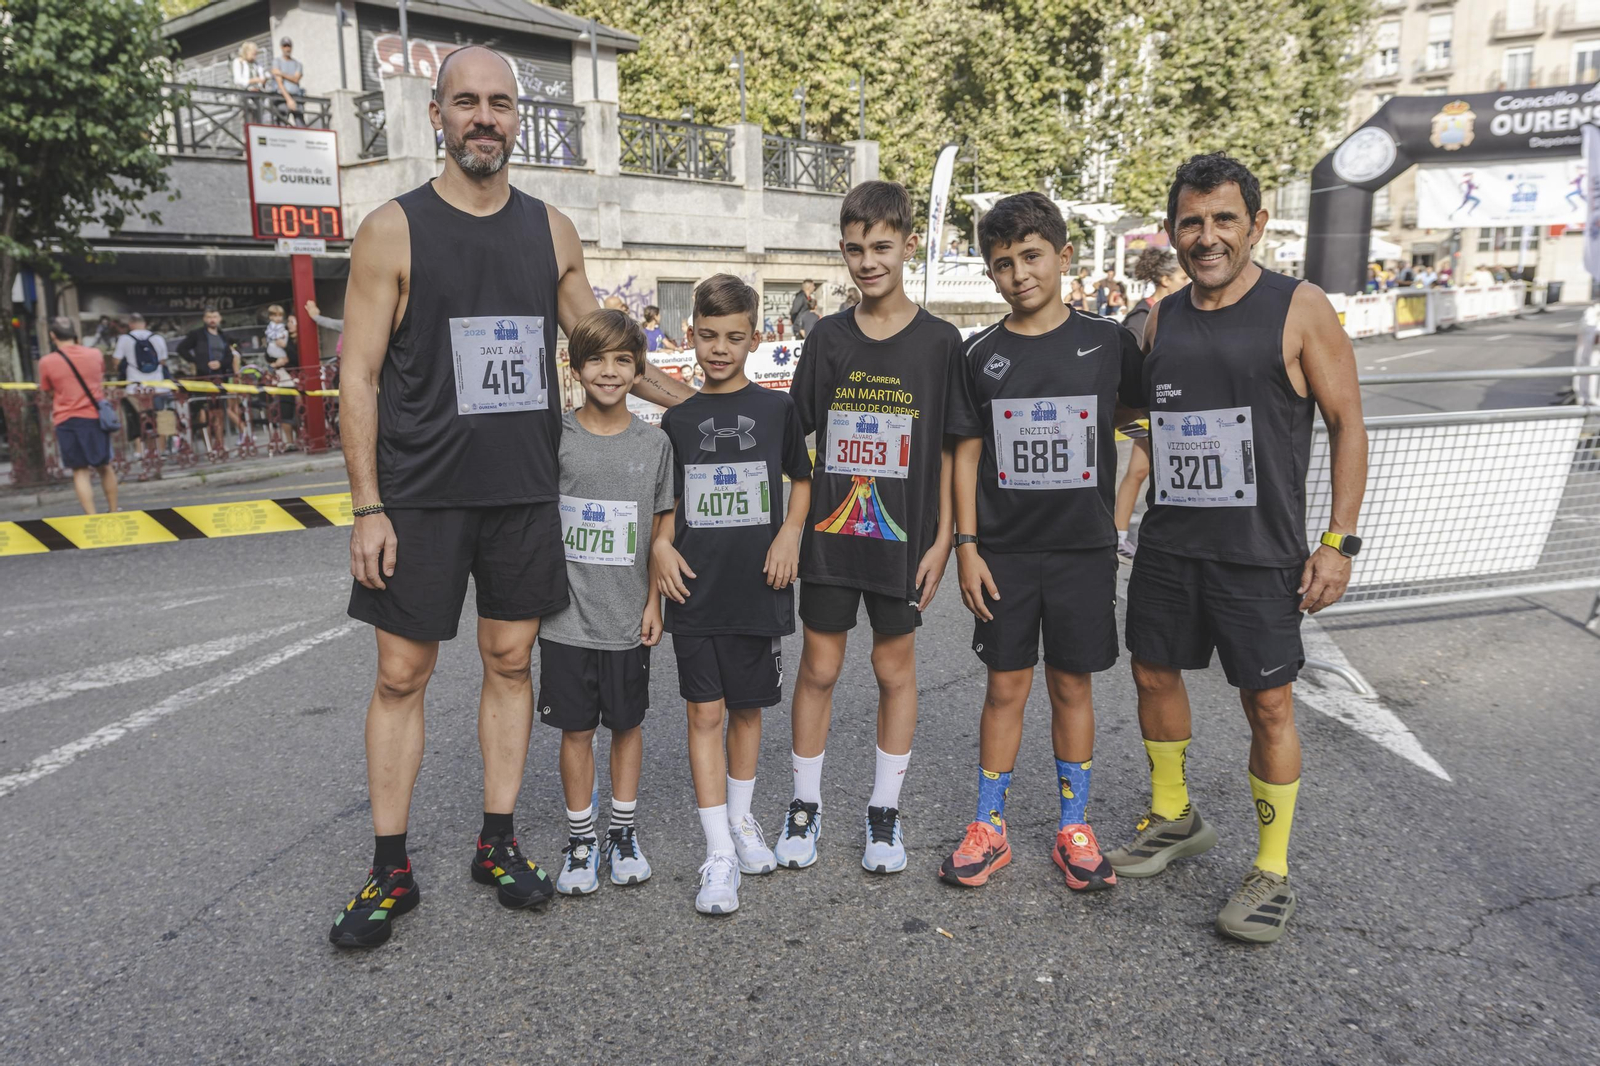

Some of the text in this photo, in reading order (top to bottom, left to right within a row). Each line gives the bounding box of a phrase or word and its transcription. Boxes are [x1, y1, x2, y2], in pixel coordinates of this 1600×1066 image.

[1494, 90, 1579, 111] Concello
[279, 165, 312, 175] Concello
[280, 174, 332, 186] OURENSE
[464, 329, 486, 337] 2026
[480, 346, 524, 355] JAVI AAA
[482, 360, 525, 395] 415
[866, 375, 901, 385] CARREIRA
[1156, 383, 1172, 391] SEVEN
[835, 387, 913, 404] SAN MARTIÑO
[1156, 389, 1182, 397] BOUTIQUE
[867, 404, 880, 413] DE
[881, 405, 920, 419] OURENSE
[832, 418, 850, 426] 2026
[1020, 426, 1060, 436] ENZITUS
[1167, 441, 1220, 450] VIZTOCHITO
[837, 439, 887, 466] 3053
[1013, 439, 1068, 473] 686
[1169, 455, 1223, 489] 320
[561, 504, 576, 513] 2026
[697, 491, 749, 516] 4075
[564, 526, 615, 553] 4076
